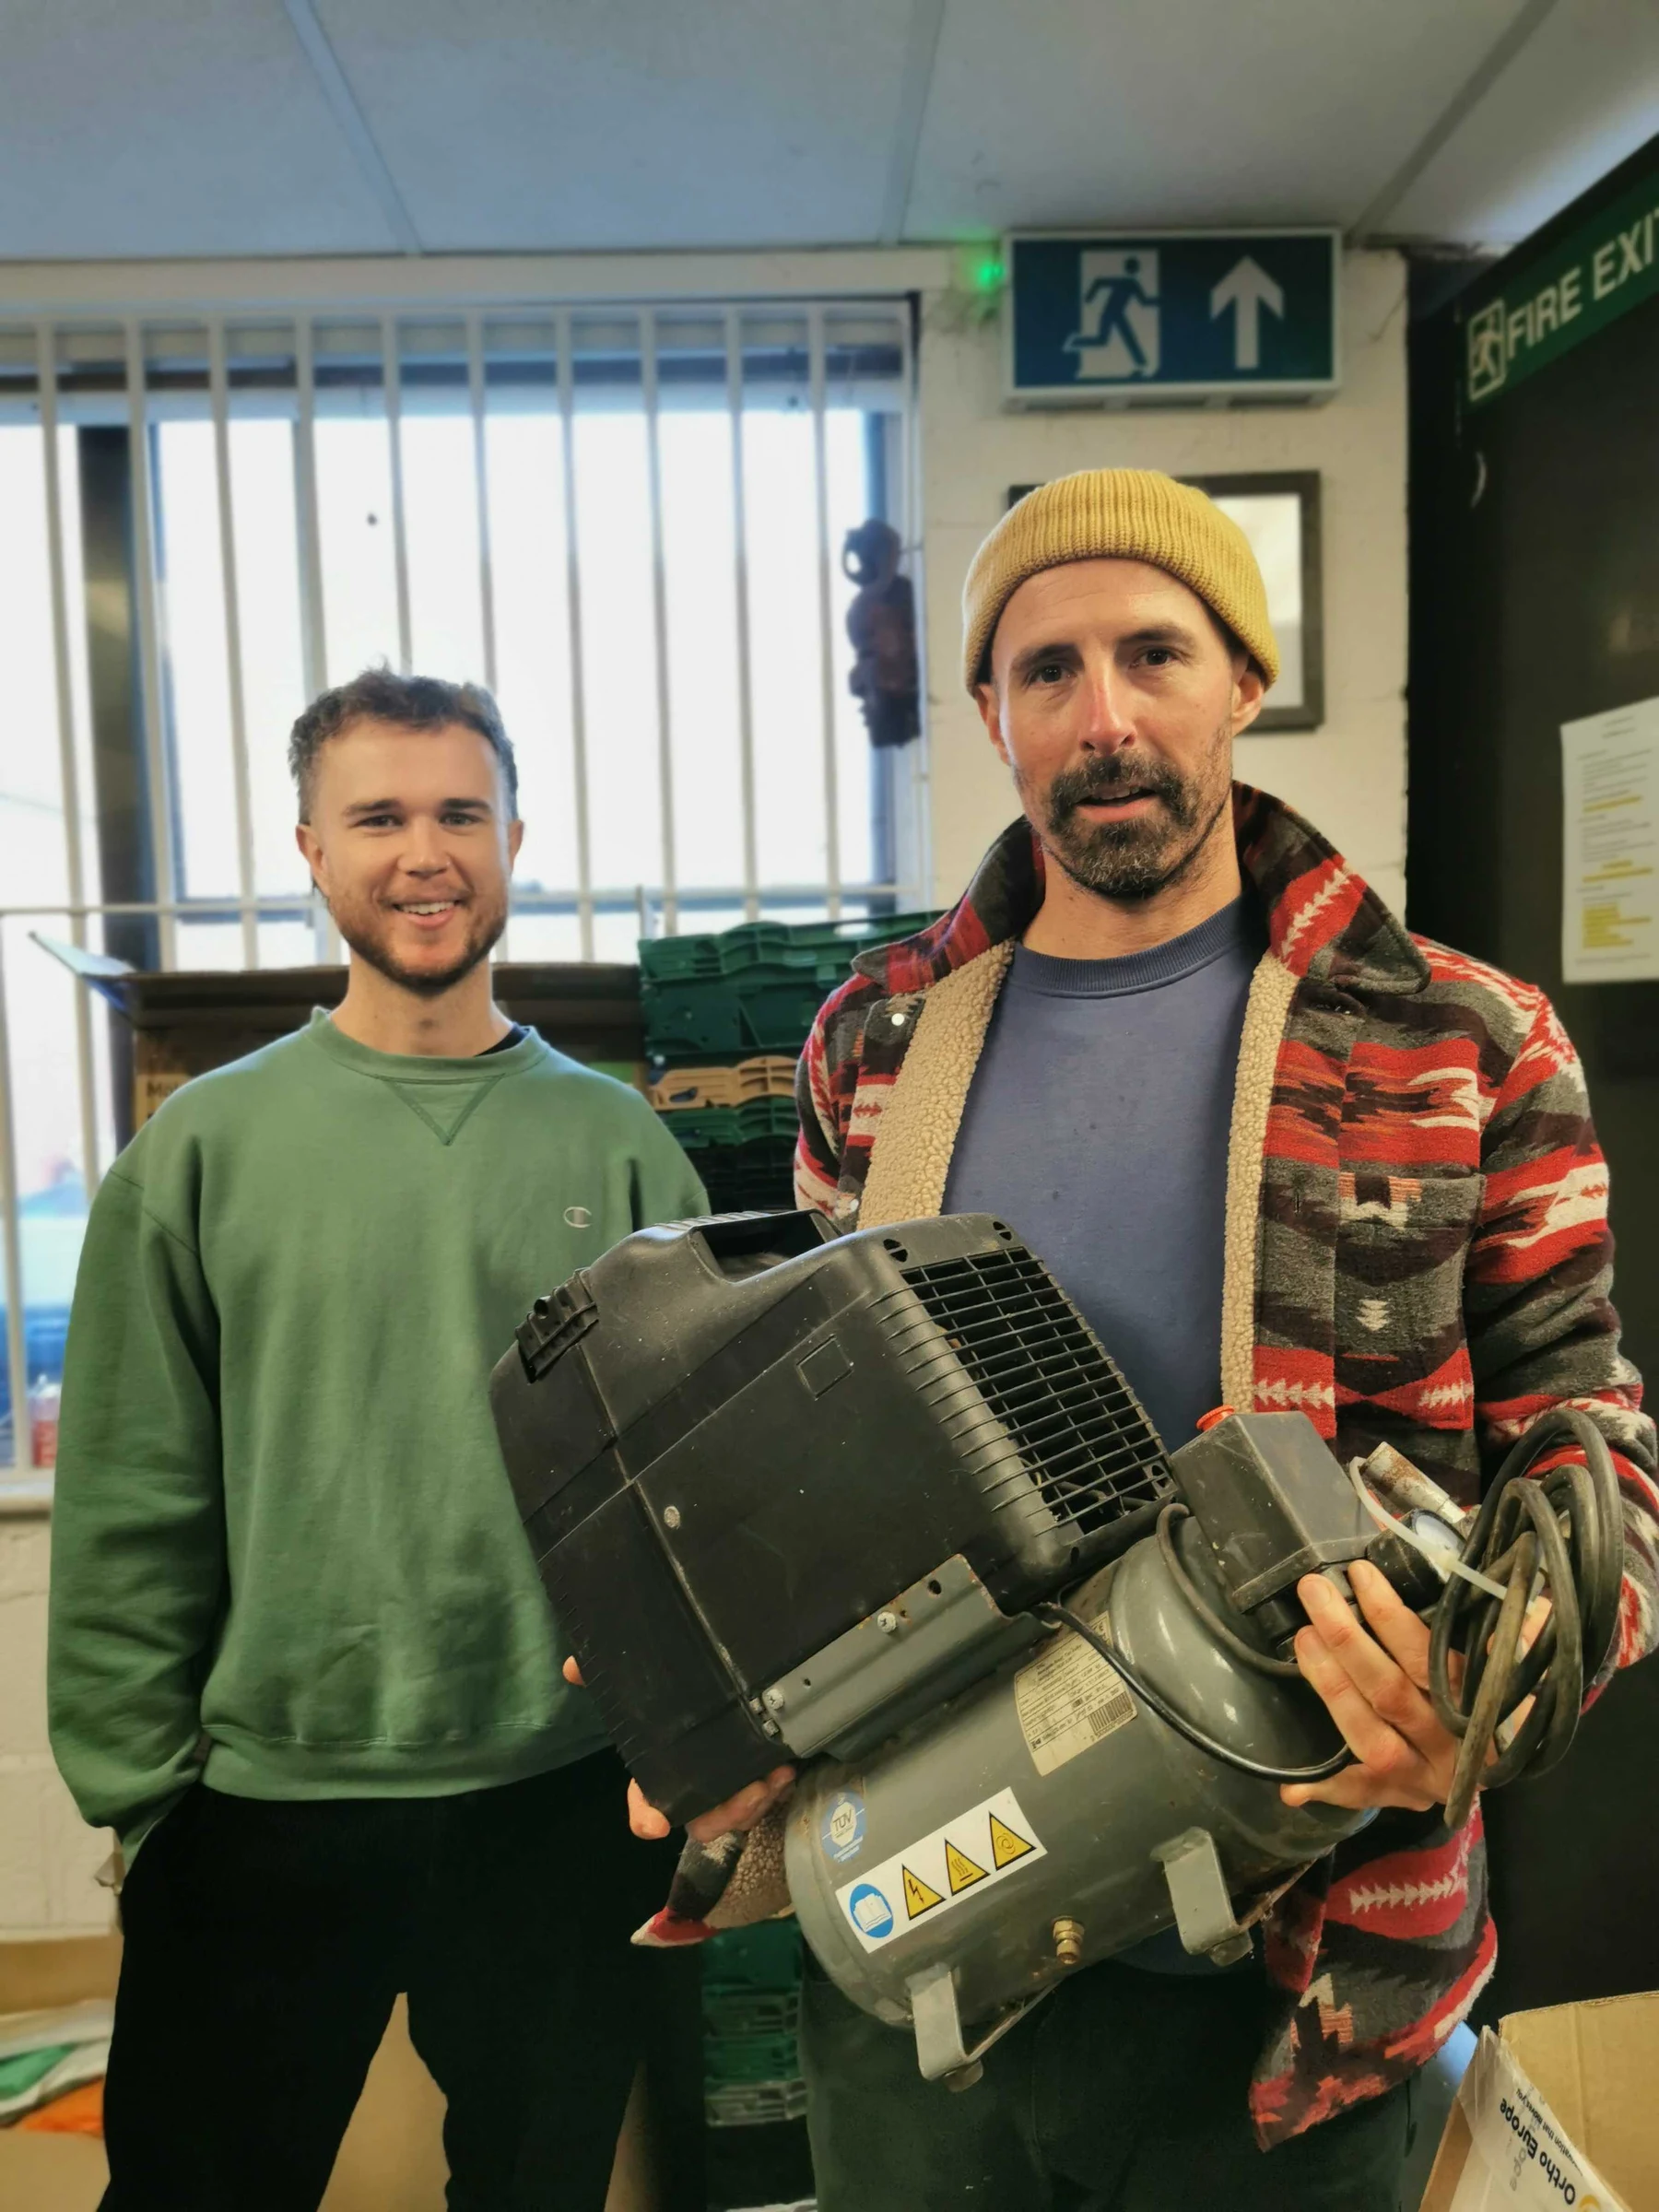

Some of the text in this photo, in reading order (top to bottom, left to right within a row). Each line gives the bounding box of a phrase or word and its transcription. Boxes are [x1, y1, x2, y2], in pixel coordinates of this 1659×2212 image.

[1508, 207, 1659, 360] FIRE EXI
[1516, 2088, 1528, 2105] you
[1500, 2098, 1538, 2159] Europe
[1542, 2122, 1555, 2141] that
[1539, 2151, 1575, 2205] Ortho
